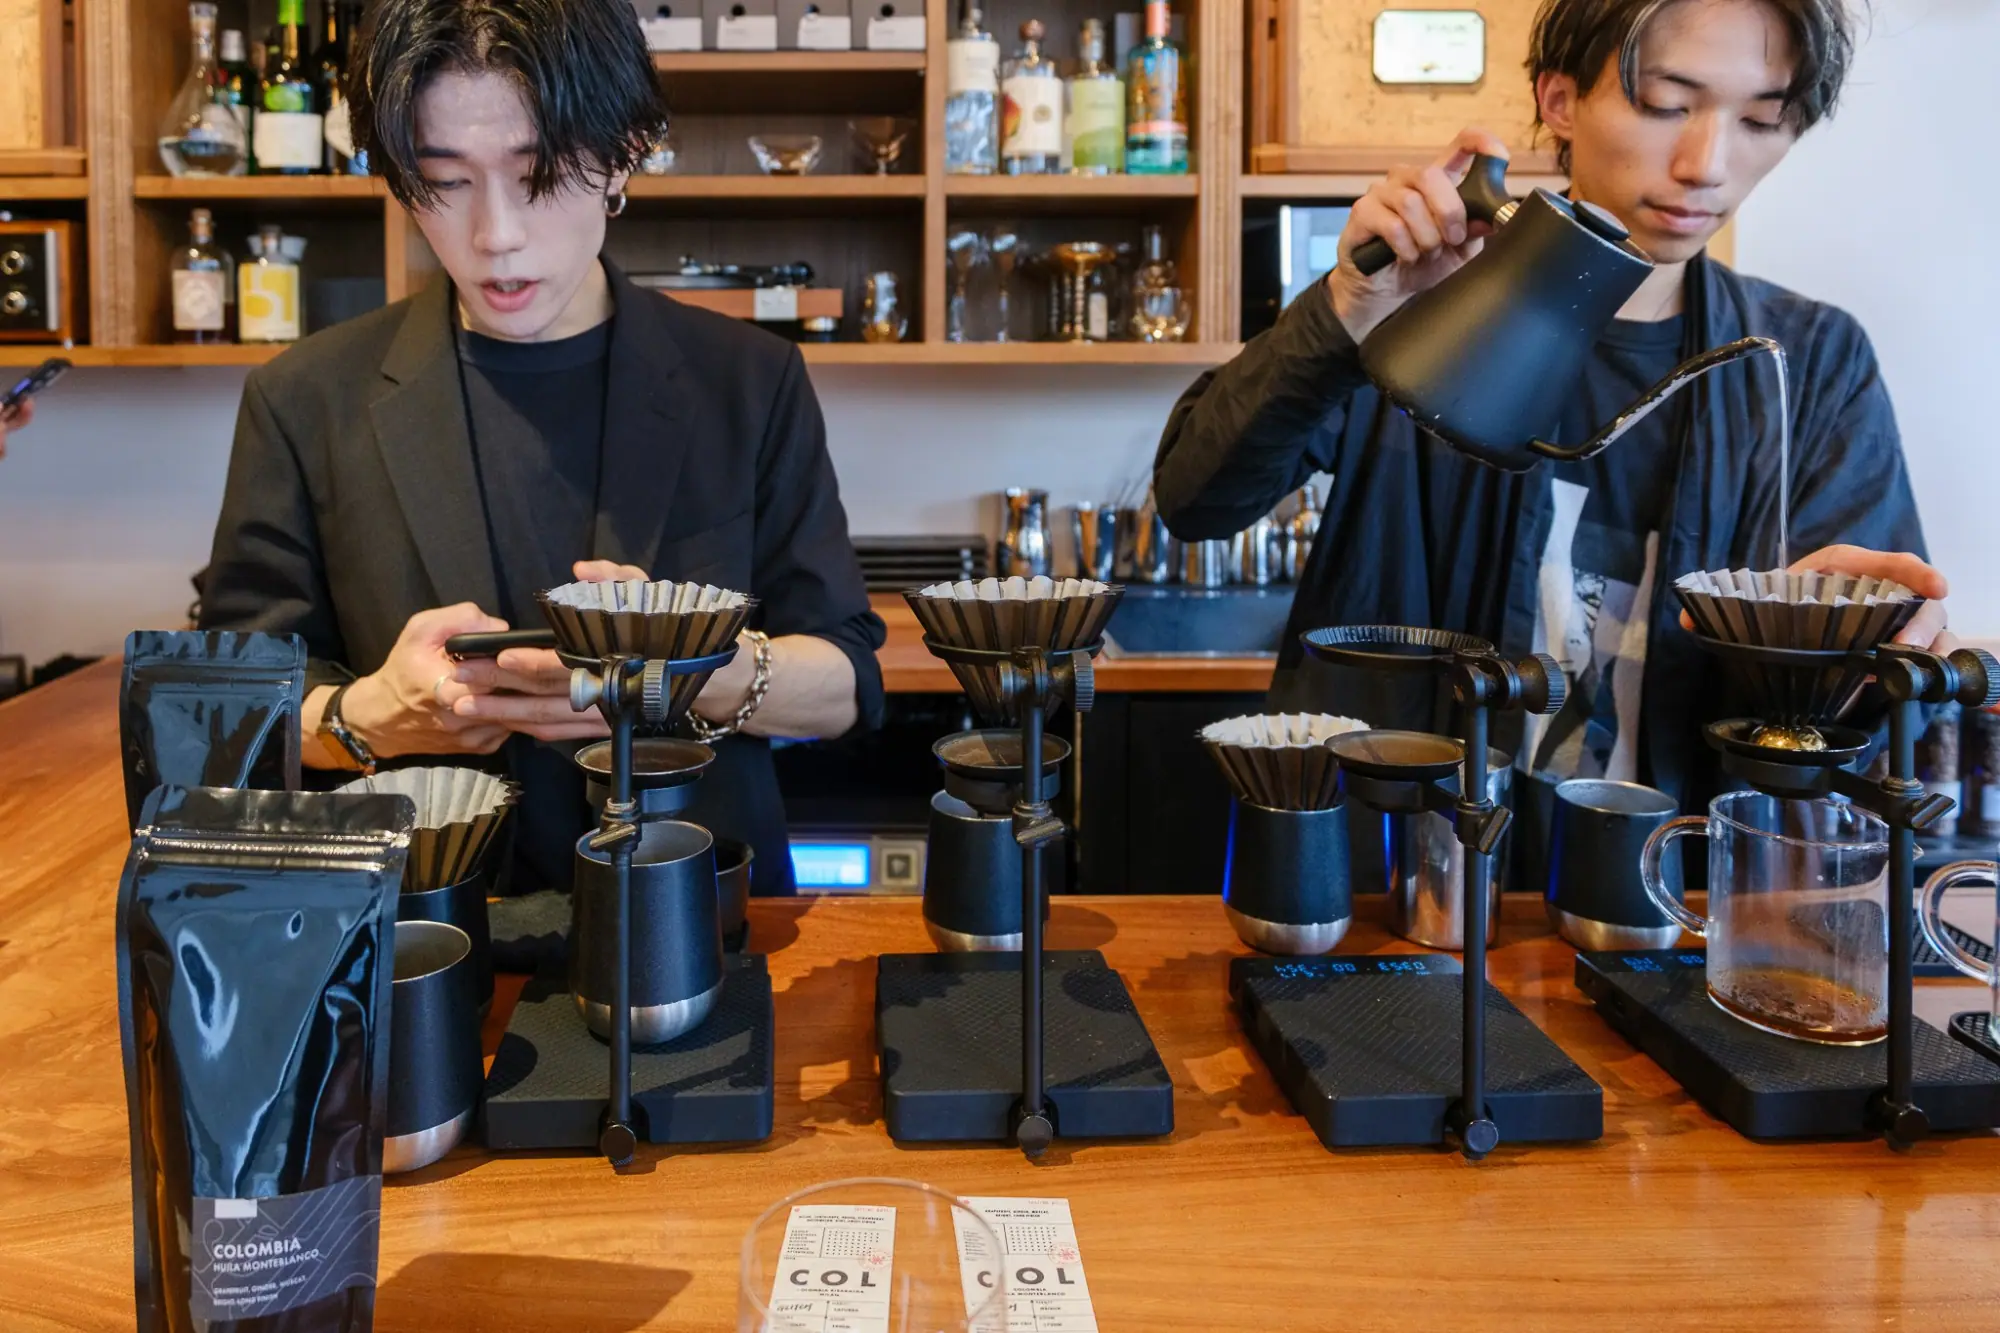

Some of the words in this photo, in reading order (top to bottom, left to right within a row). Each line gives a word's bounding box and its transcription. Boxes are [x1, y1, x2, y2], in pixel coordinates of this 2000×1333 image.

[213, 1237, 302, 1260] COLOMBIA
[213, 1262, 241, 1273] HUILA
[243, 1248, 319, 1272] MONTEBLANCO
[790, 1269, 876, 1287] COL
[977, 1267, 1075, 1288] COL
